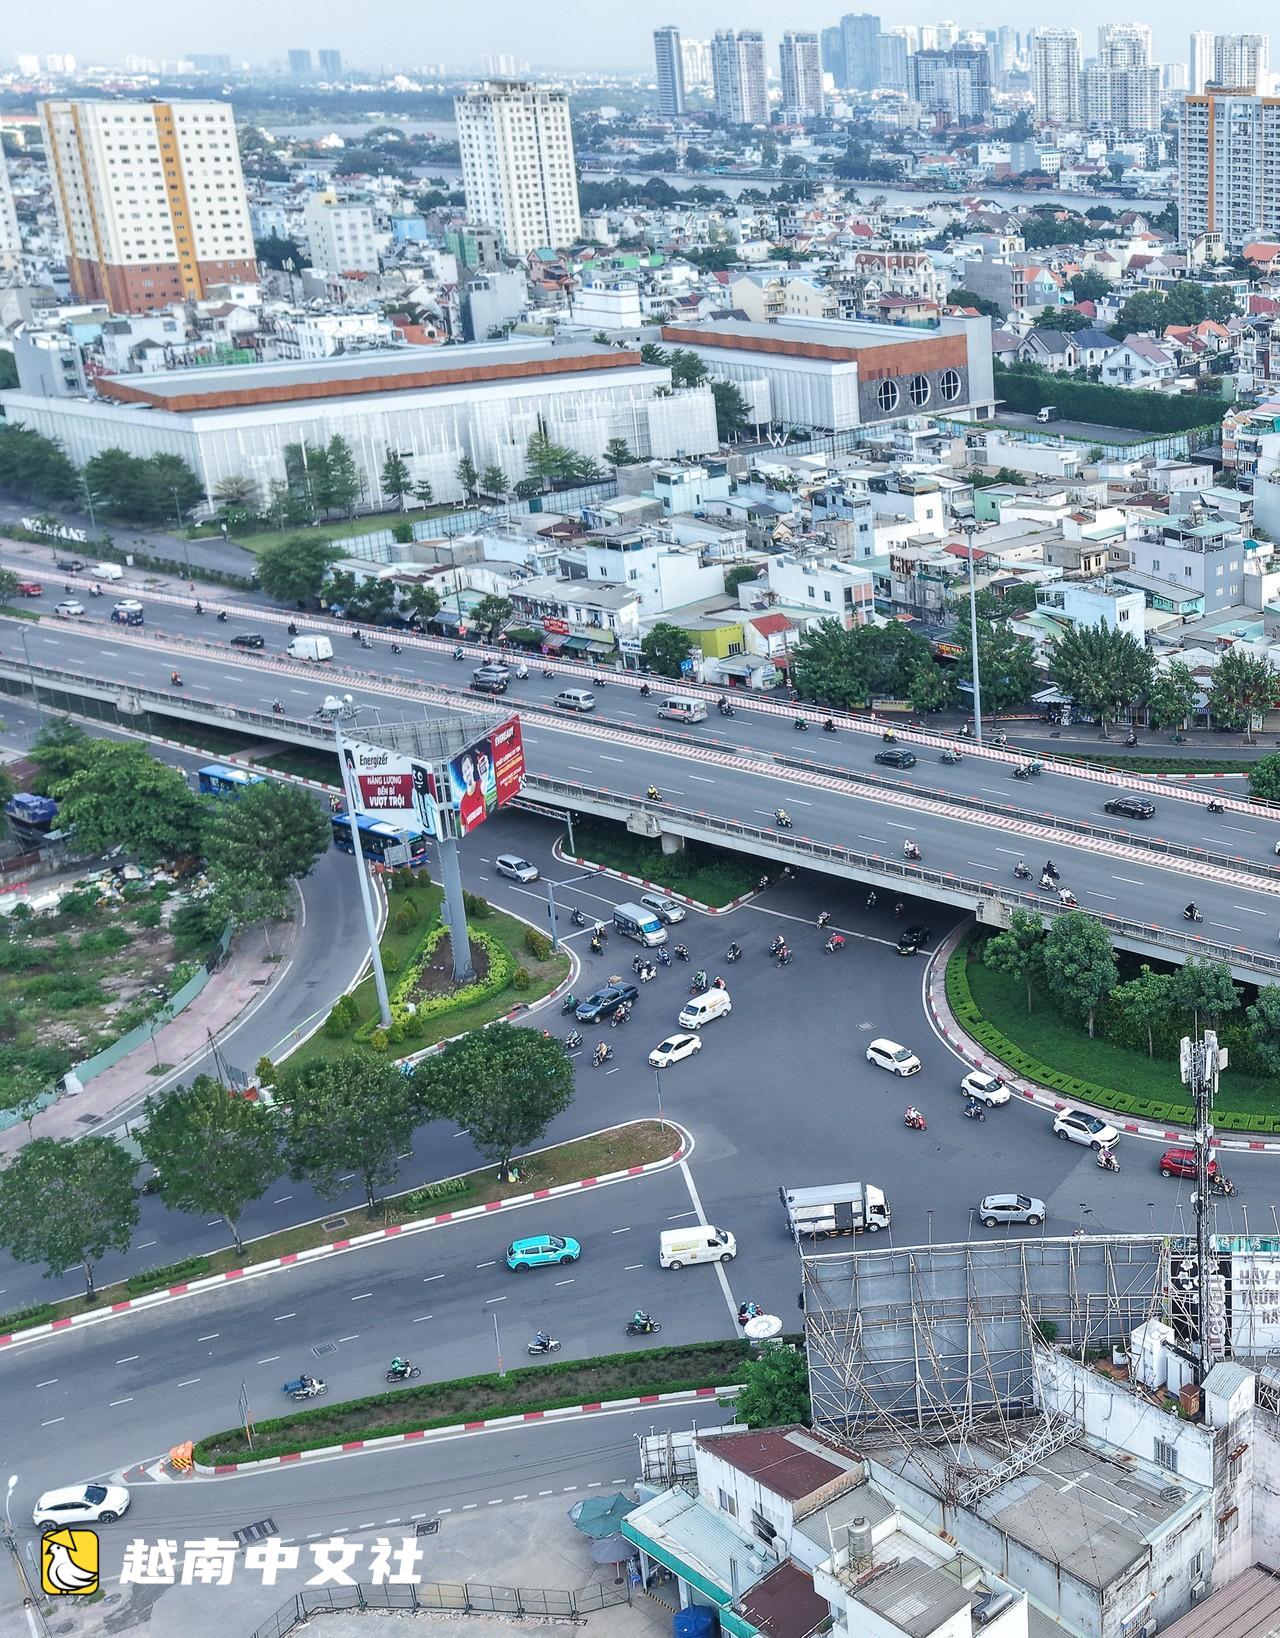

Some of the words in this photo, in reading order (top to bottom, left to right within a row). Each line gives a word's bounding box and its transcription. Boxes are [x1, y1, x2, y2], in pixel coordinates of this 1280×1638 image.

[494, 726, 514, 748] EVEREADY
[359, 754, 388, 768] Energizer
[369, 795, 388, 809] VƯỢT
[388, 793, 405, 809] TRỘI
[1240, 1267, 1270, 1285] HÃY
